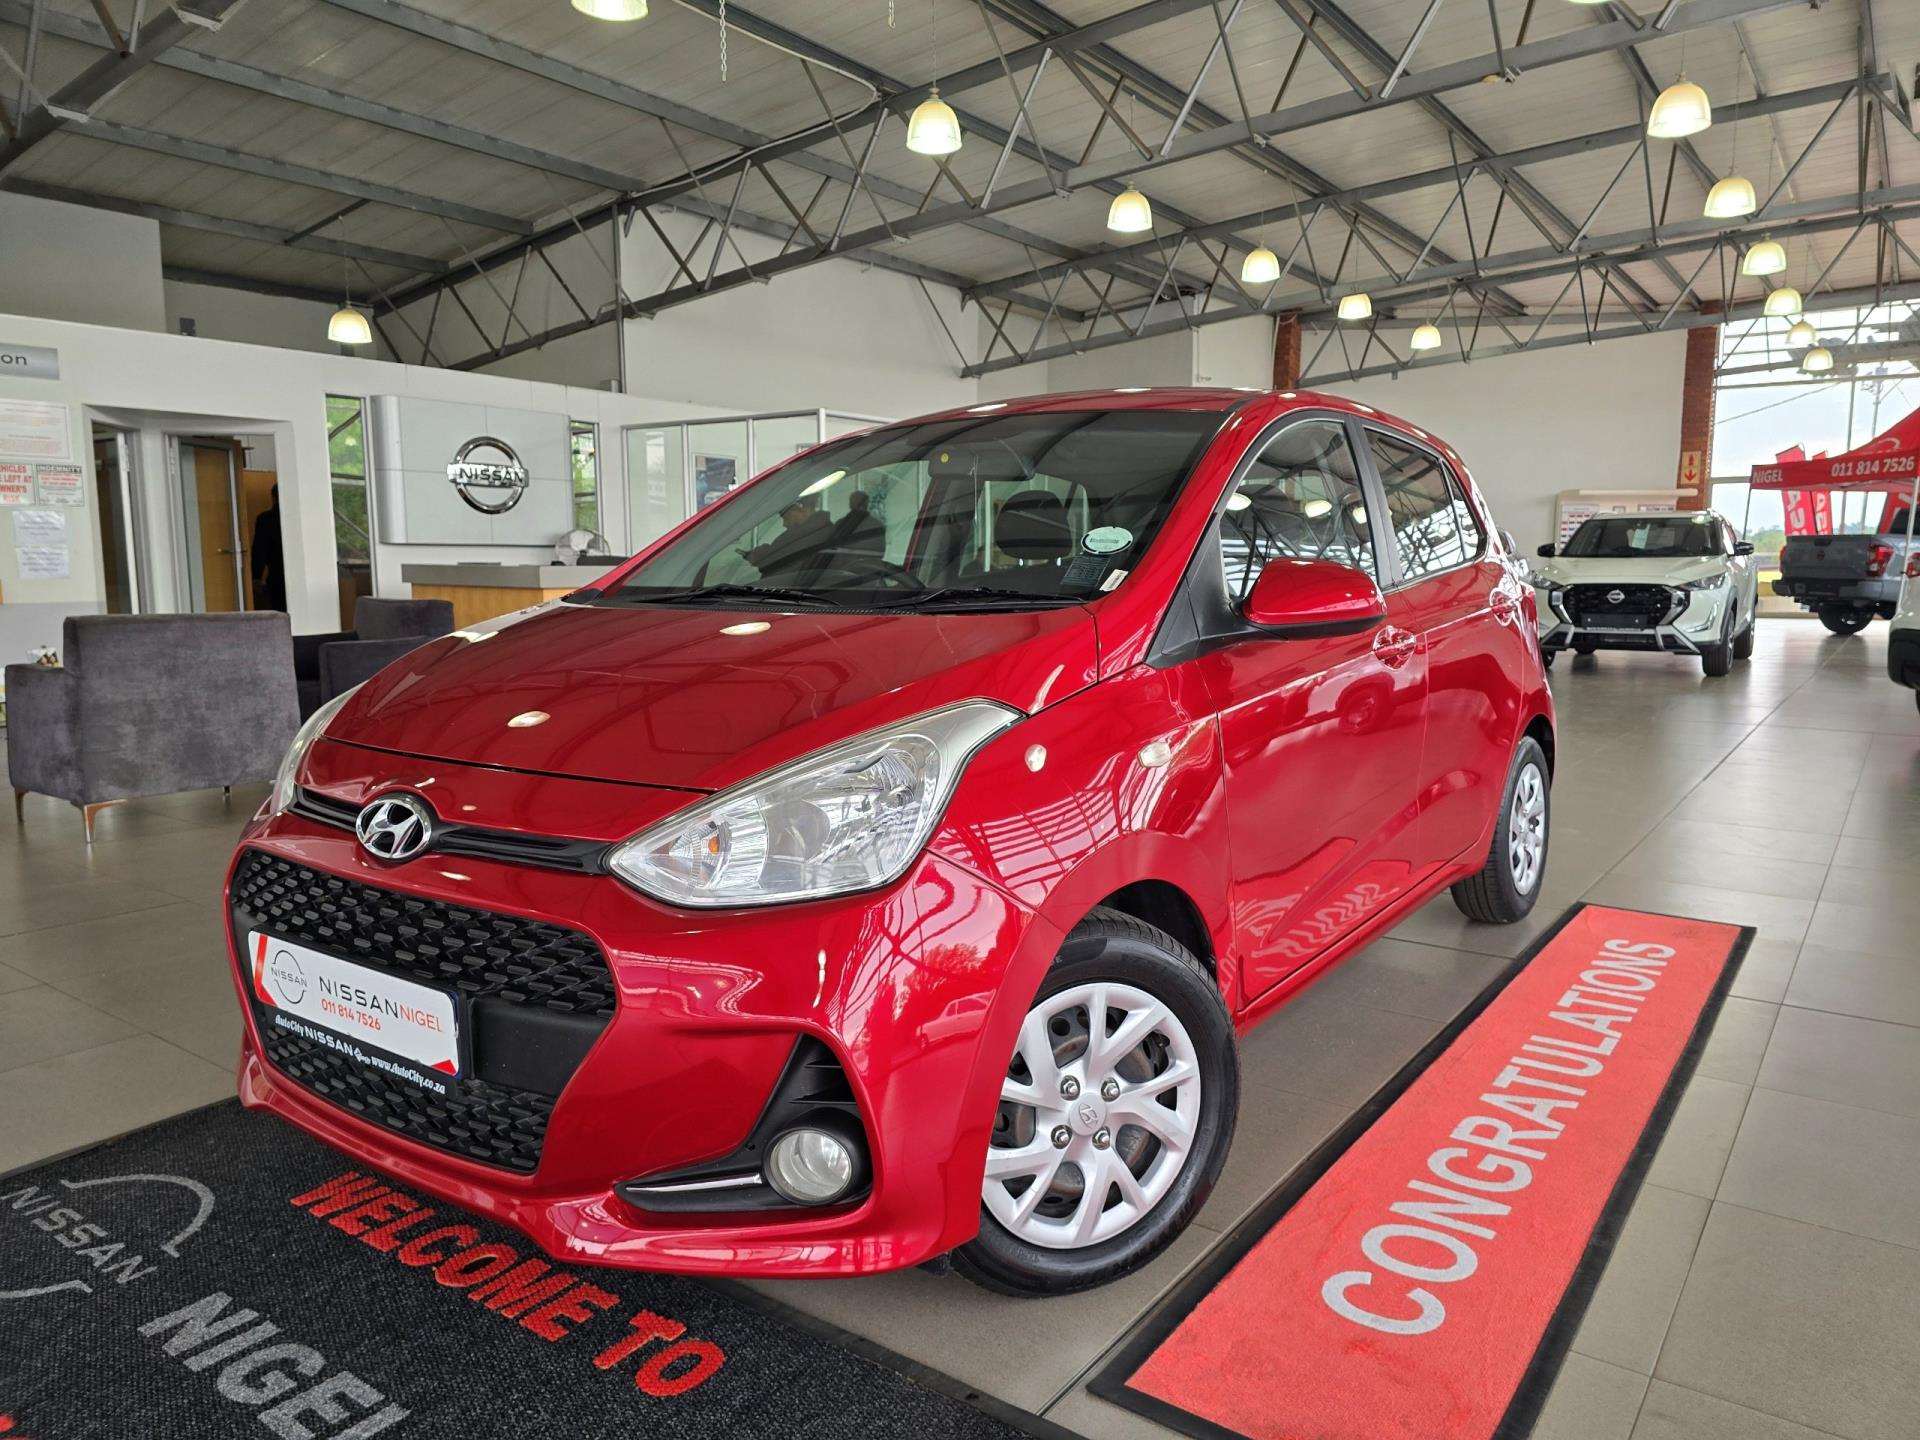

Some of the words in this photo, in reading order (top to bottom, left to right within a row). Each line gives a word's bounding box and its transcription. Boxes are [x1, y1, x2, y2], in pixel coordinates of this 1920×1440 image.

[0, 464, 27, 473] HICLES
[459, 467, 523, 482] NISSAN
[1752, 470, 1783, 484] NIGEL
[1831, 463, 1853, 477] 011
[1856, 460, 1880, 474] 814
[1882, 456, 1915, 472] 7526
[271, 966, 308, 988] NISSAN
[321, 998, 337, 1015] 011
[338, 1005, 354, 1021] 814
[357, 1011, 381, 1031] 7526
[275, 1014, 304, 1037] AutoCity
[305, 1026, 354, 1057] NISSAN
[1321, 938, 1677, 1336] CONGRATULATIONS
[0, 1185, 158, 1285] NISSAN
[290, 1170, 620, 1343] WELCOME
[593, 1309, 726, 1398] TO
